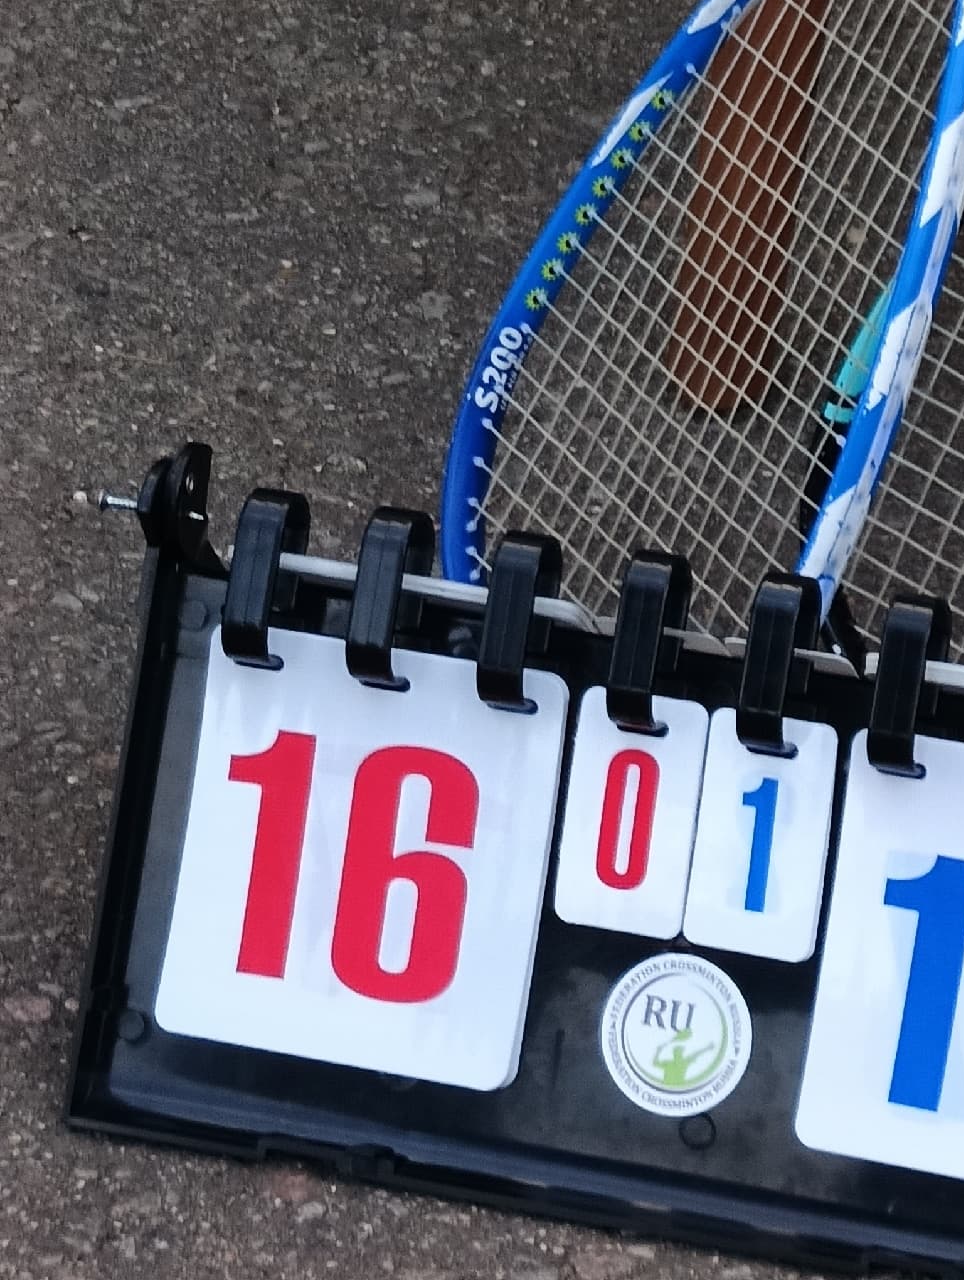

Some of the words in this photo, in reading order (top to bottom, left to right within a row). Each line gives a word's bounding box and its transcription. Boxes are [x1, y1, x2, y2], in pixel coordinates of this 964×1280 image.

[475, 327, 523, 413] S200
[230, 732, 476, 1001] 16
[597, 750, 658, 889] 0
[742, 777, 779, 913] 1
[641, 993, 696, 1032] RU
